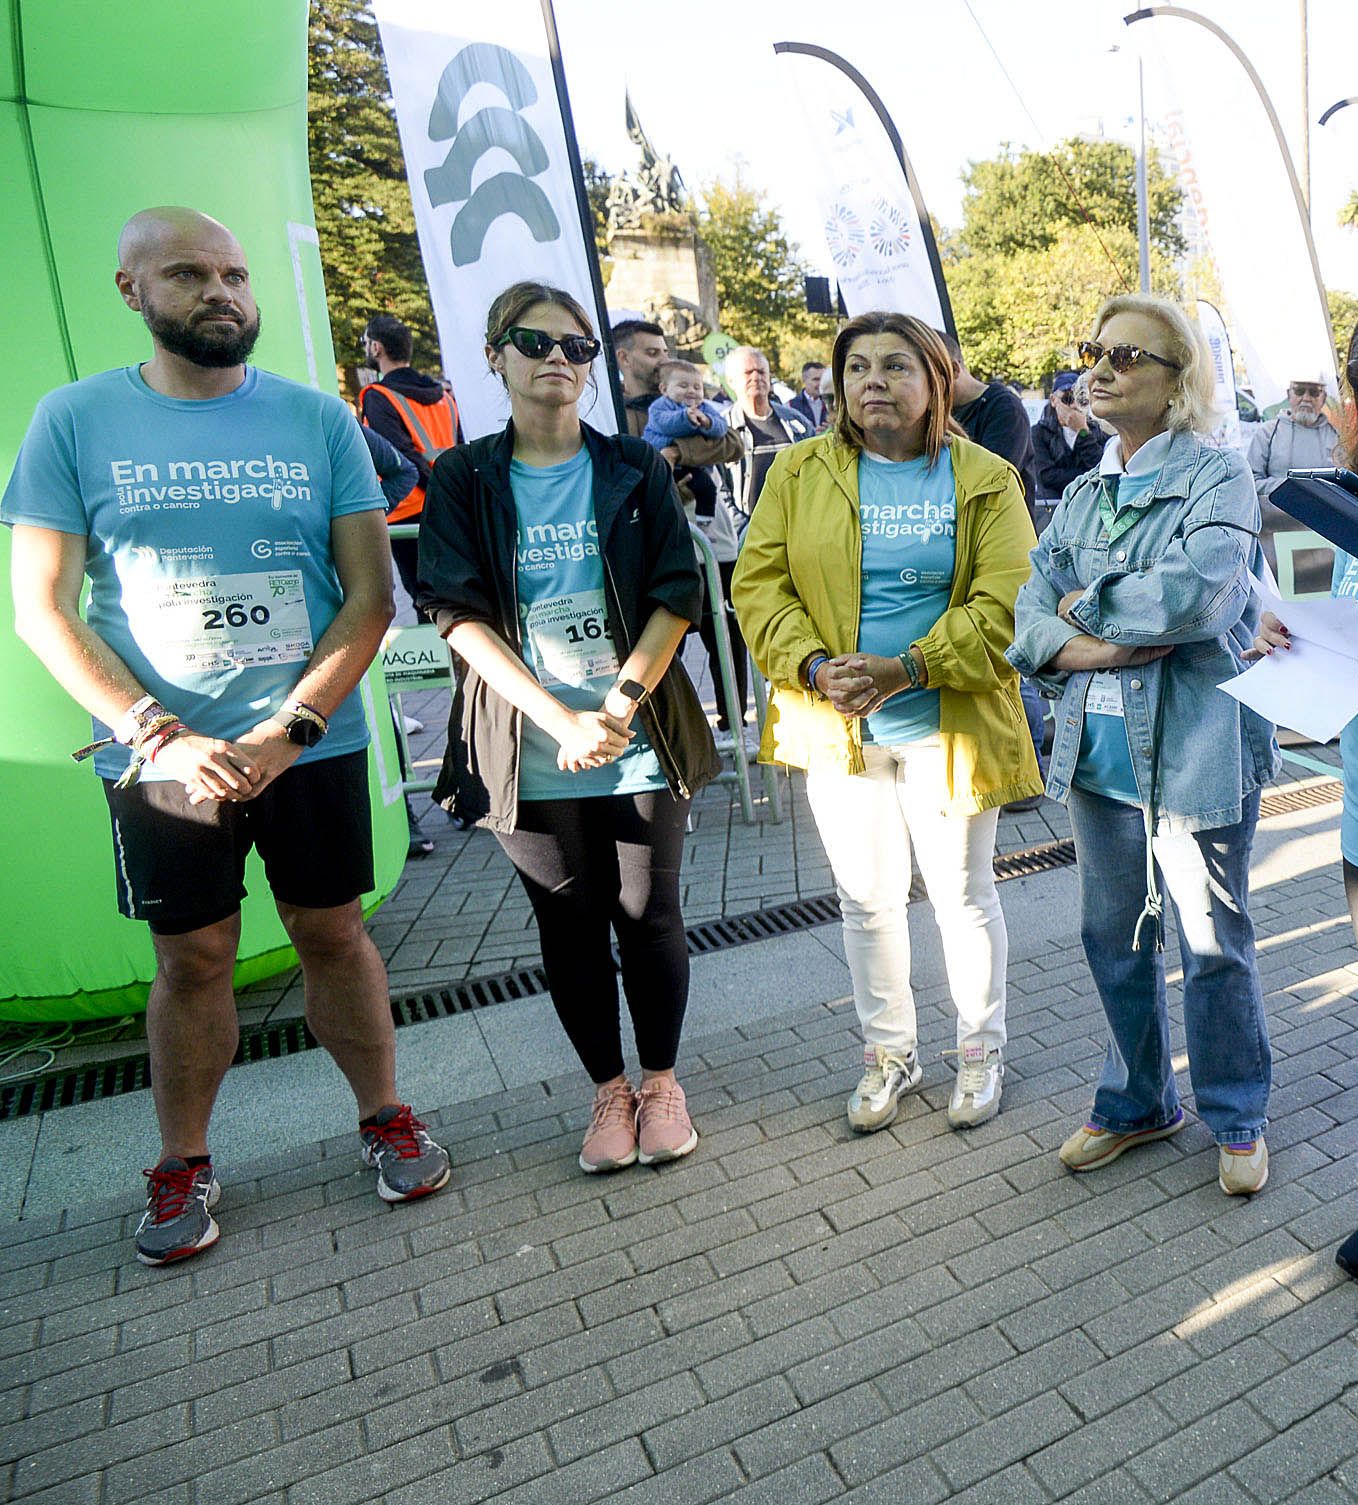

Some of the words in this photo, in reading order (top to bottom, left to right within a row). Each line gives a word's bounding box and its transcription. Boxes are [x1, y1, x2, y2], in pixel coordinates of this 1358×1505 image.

[111, 460, 159, 485] En
[168, 455, 310, 481] marcha
[126, 479, 311, 507] investigación
[120, 504, 151, 514] contra
[860, 500, 955, 520] marcha
[160, 545, 213, 555] Deputación
[161, 553, 214, 562] Pontevedra
[518, 541, 599, 564] vestiga
[525, 562, 555, 571] cancro
[202, 603, 271, 630] 260
[547, 607, 604, 622] investigación
